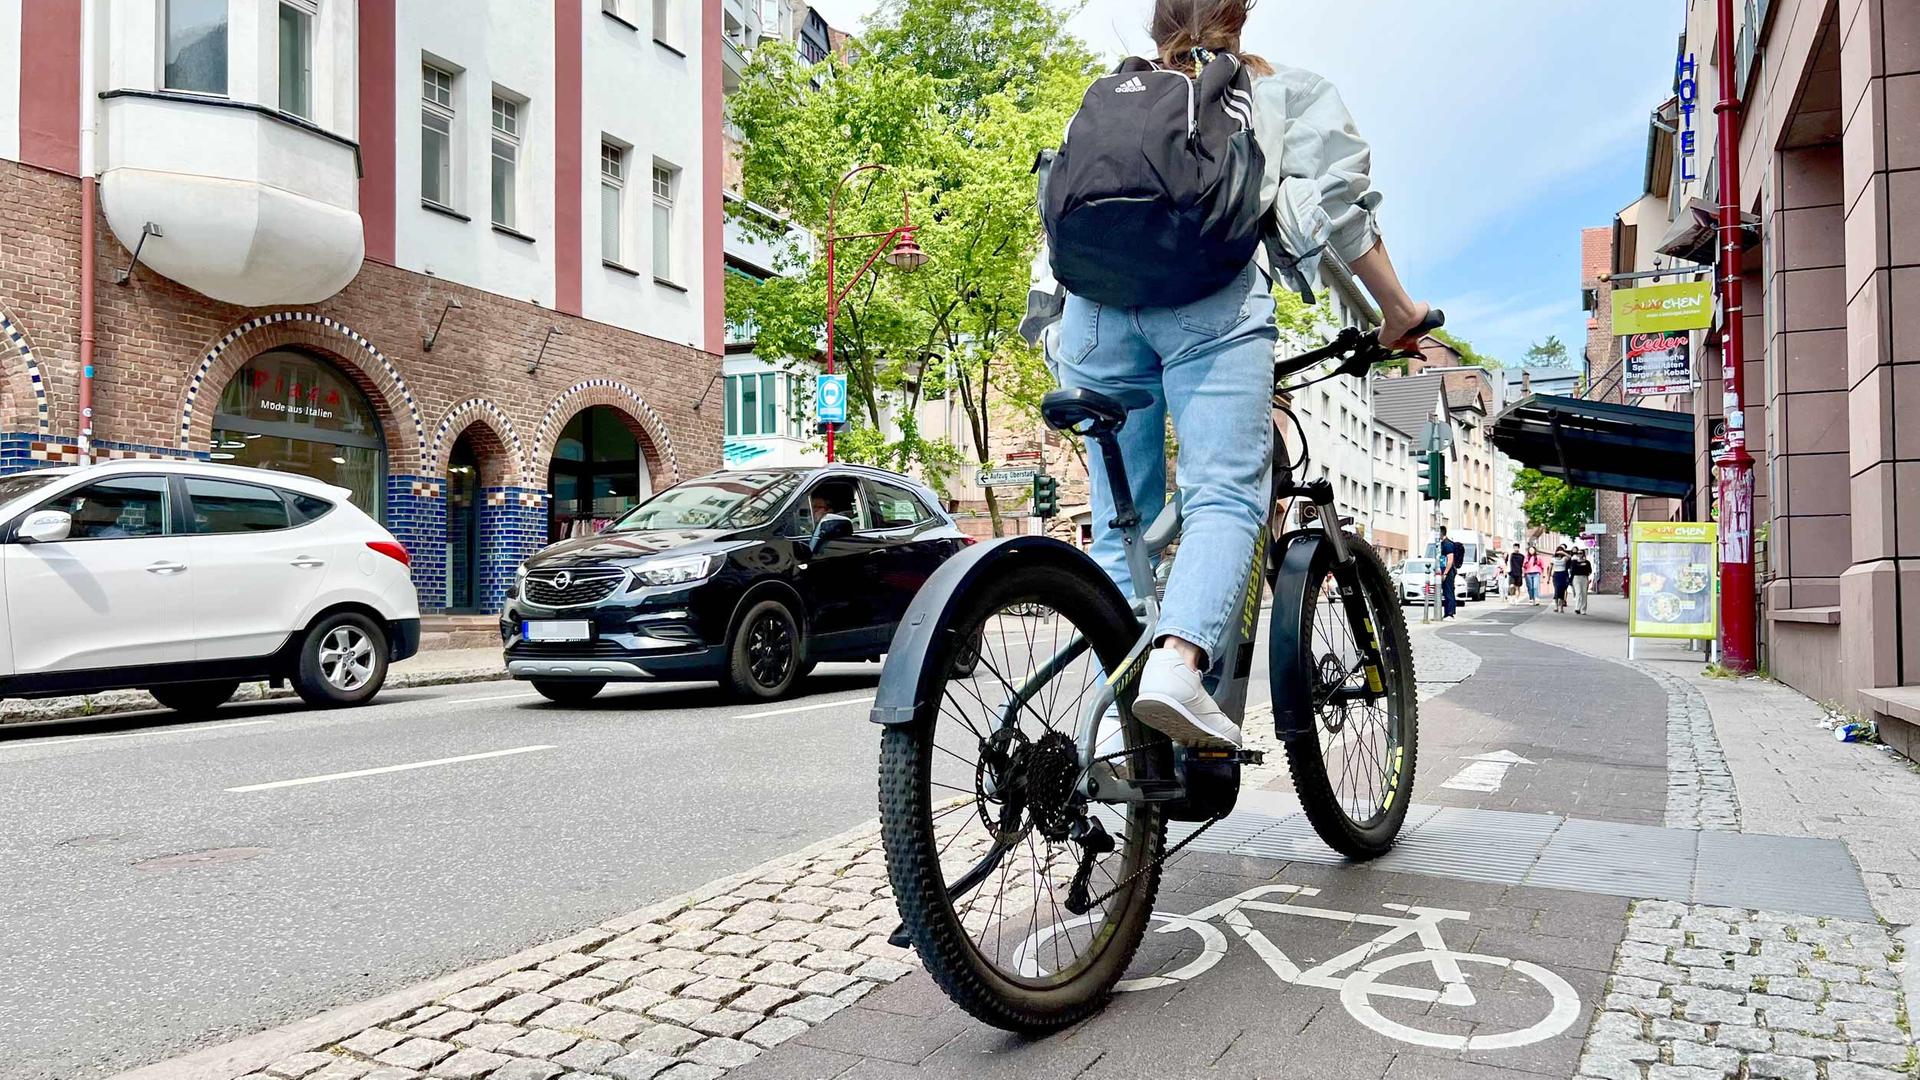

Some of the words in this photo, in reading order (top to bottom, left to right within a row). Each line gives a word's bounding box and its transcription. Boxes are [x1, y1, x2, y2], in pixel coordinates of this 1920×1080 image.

[1679, 53, 1695, 180] HOTEL
[1630, 333, 1688, 353] Ceder
[1627, 371, 1654, 379] Burger
[1664, 368, 1690, 377] Kebab
[261, 400, 285, 412] Mode
[287, 405, 303, 414] aus
[305, 406, 333, 418] Italien
[990, 473, 1009, 481] Aufzug
